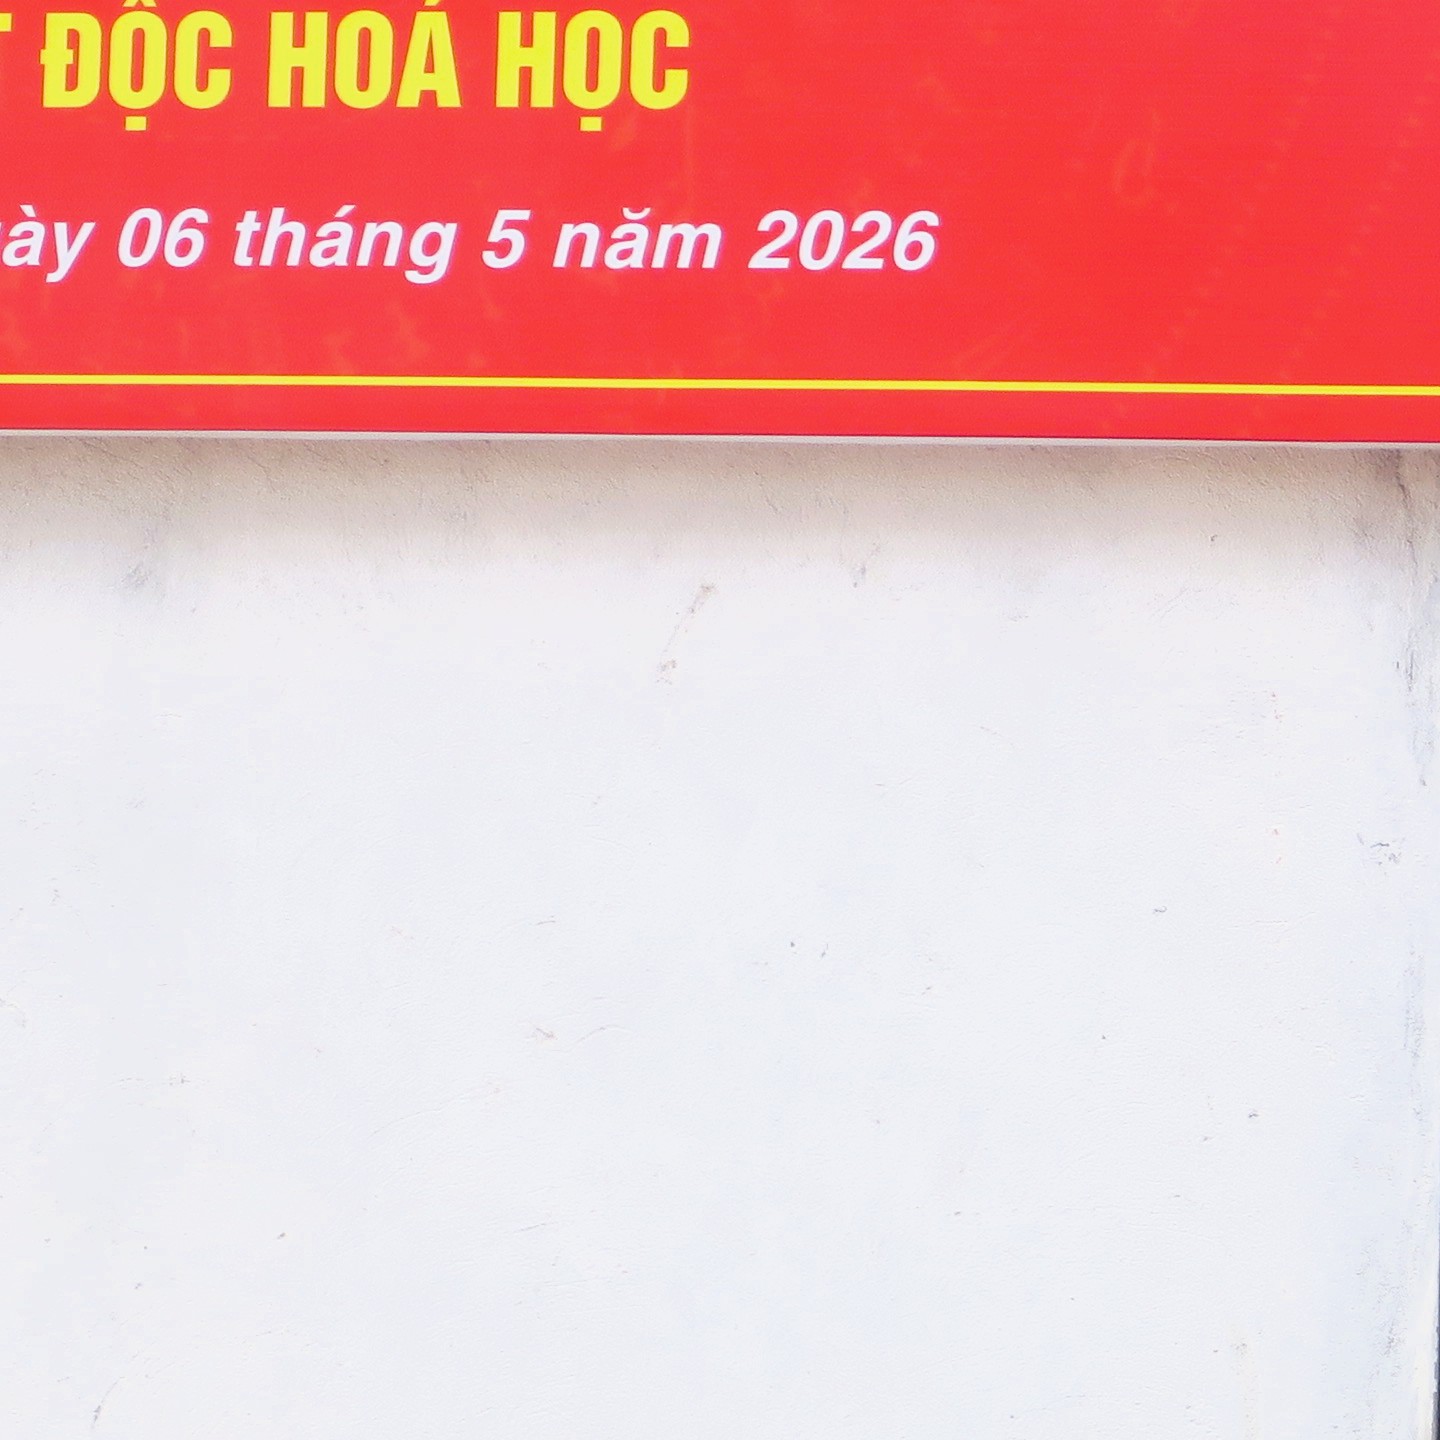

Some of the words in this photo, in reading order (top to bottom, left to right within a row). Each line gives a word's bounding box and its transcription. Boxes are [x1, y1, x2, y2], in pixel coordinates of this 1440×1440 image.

[39, 0, 233, 132] ĐỘC
[267, 0, 462, 110] HOÁ
[495, 9, 690, 132] HỌC
[0, 204, 96, 283] ày
[118, 207, 209, 268] 06
[233, 204, 458, 284] tháng
[482, 209, 531, 269] 5
[552, 207, 722, 270] năm
[747, 209, 940, 271] 2026
